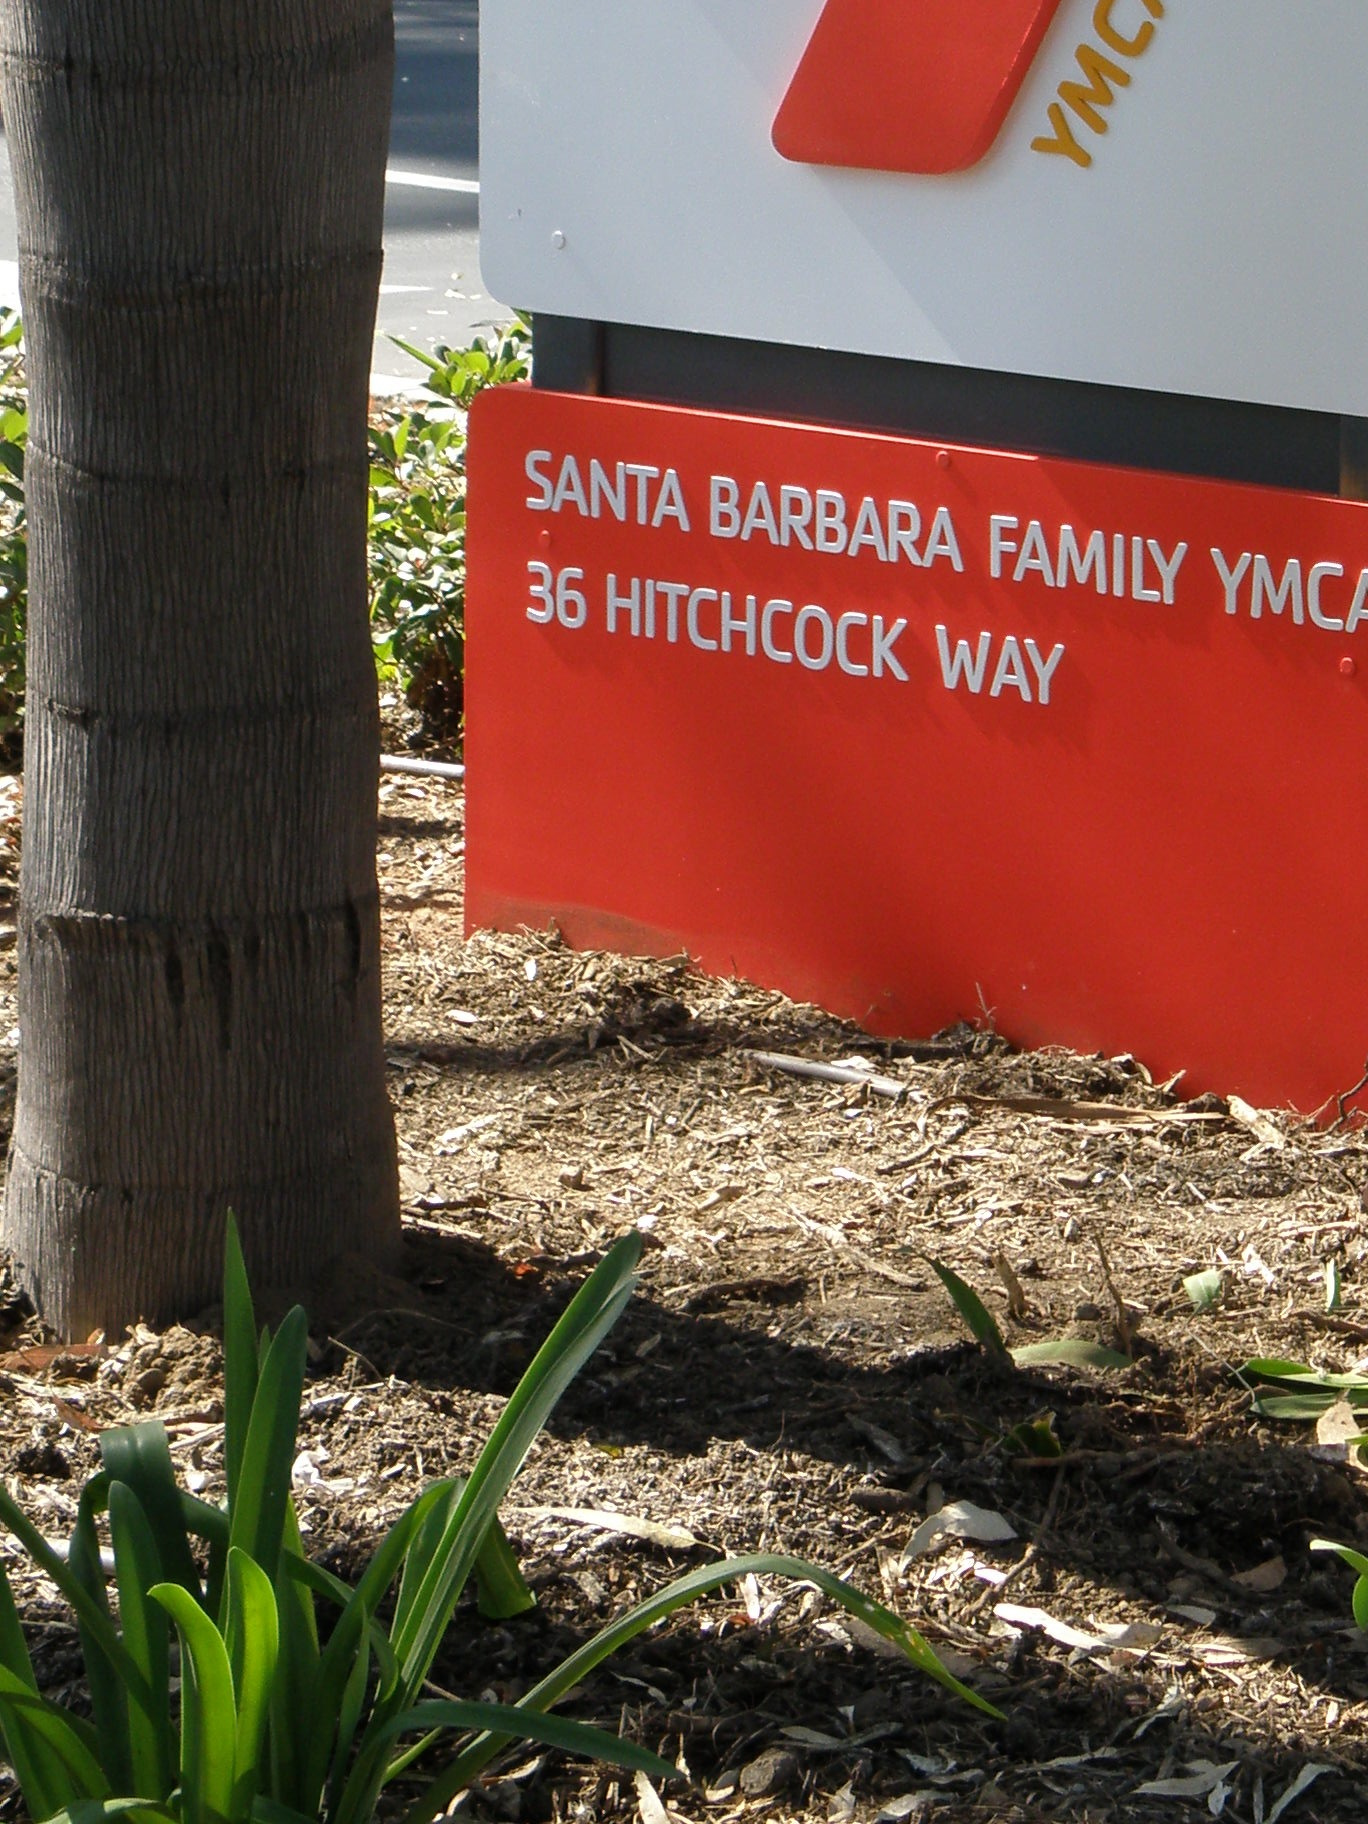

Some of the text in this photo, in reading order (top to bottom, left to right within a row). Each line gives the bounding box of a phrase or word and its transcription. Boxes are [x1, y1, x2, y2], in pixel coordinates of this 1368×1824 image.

[524, 448, 692, 533] SANTA
[708, 474, 965, 574] BARBARA
[988, 513, 1189, 606] FAMILY
[525, 559, 1066, 706] 36 HITCHCOCK WAY
